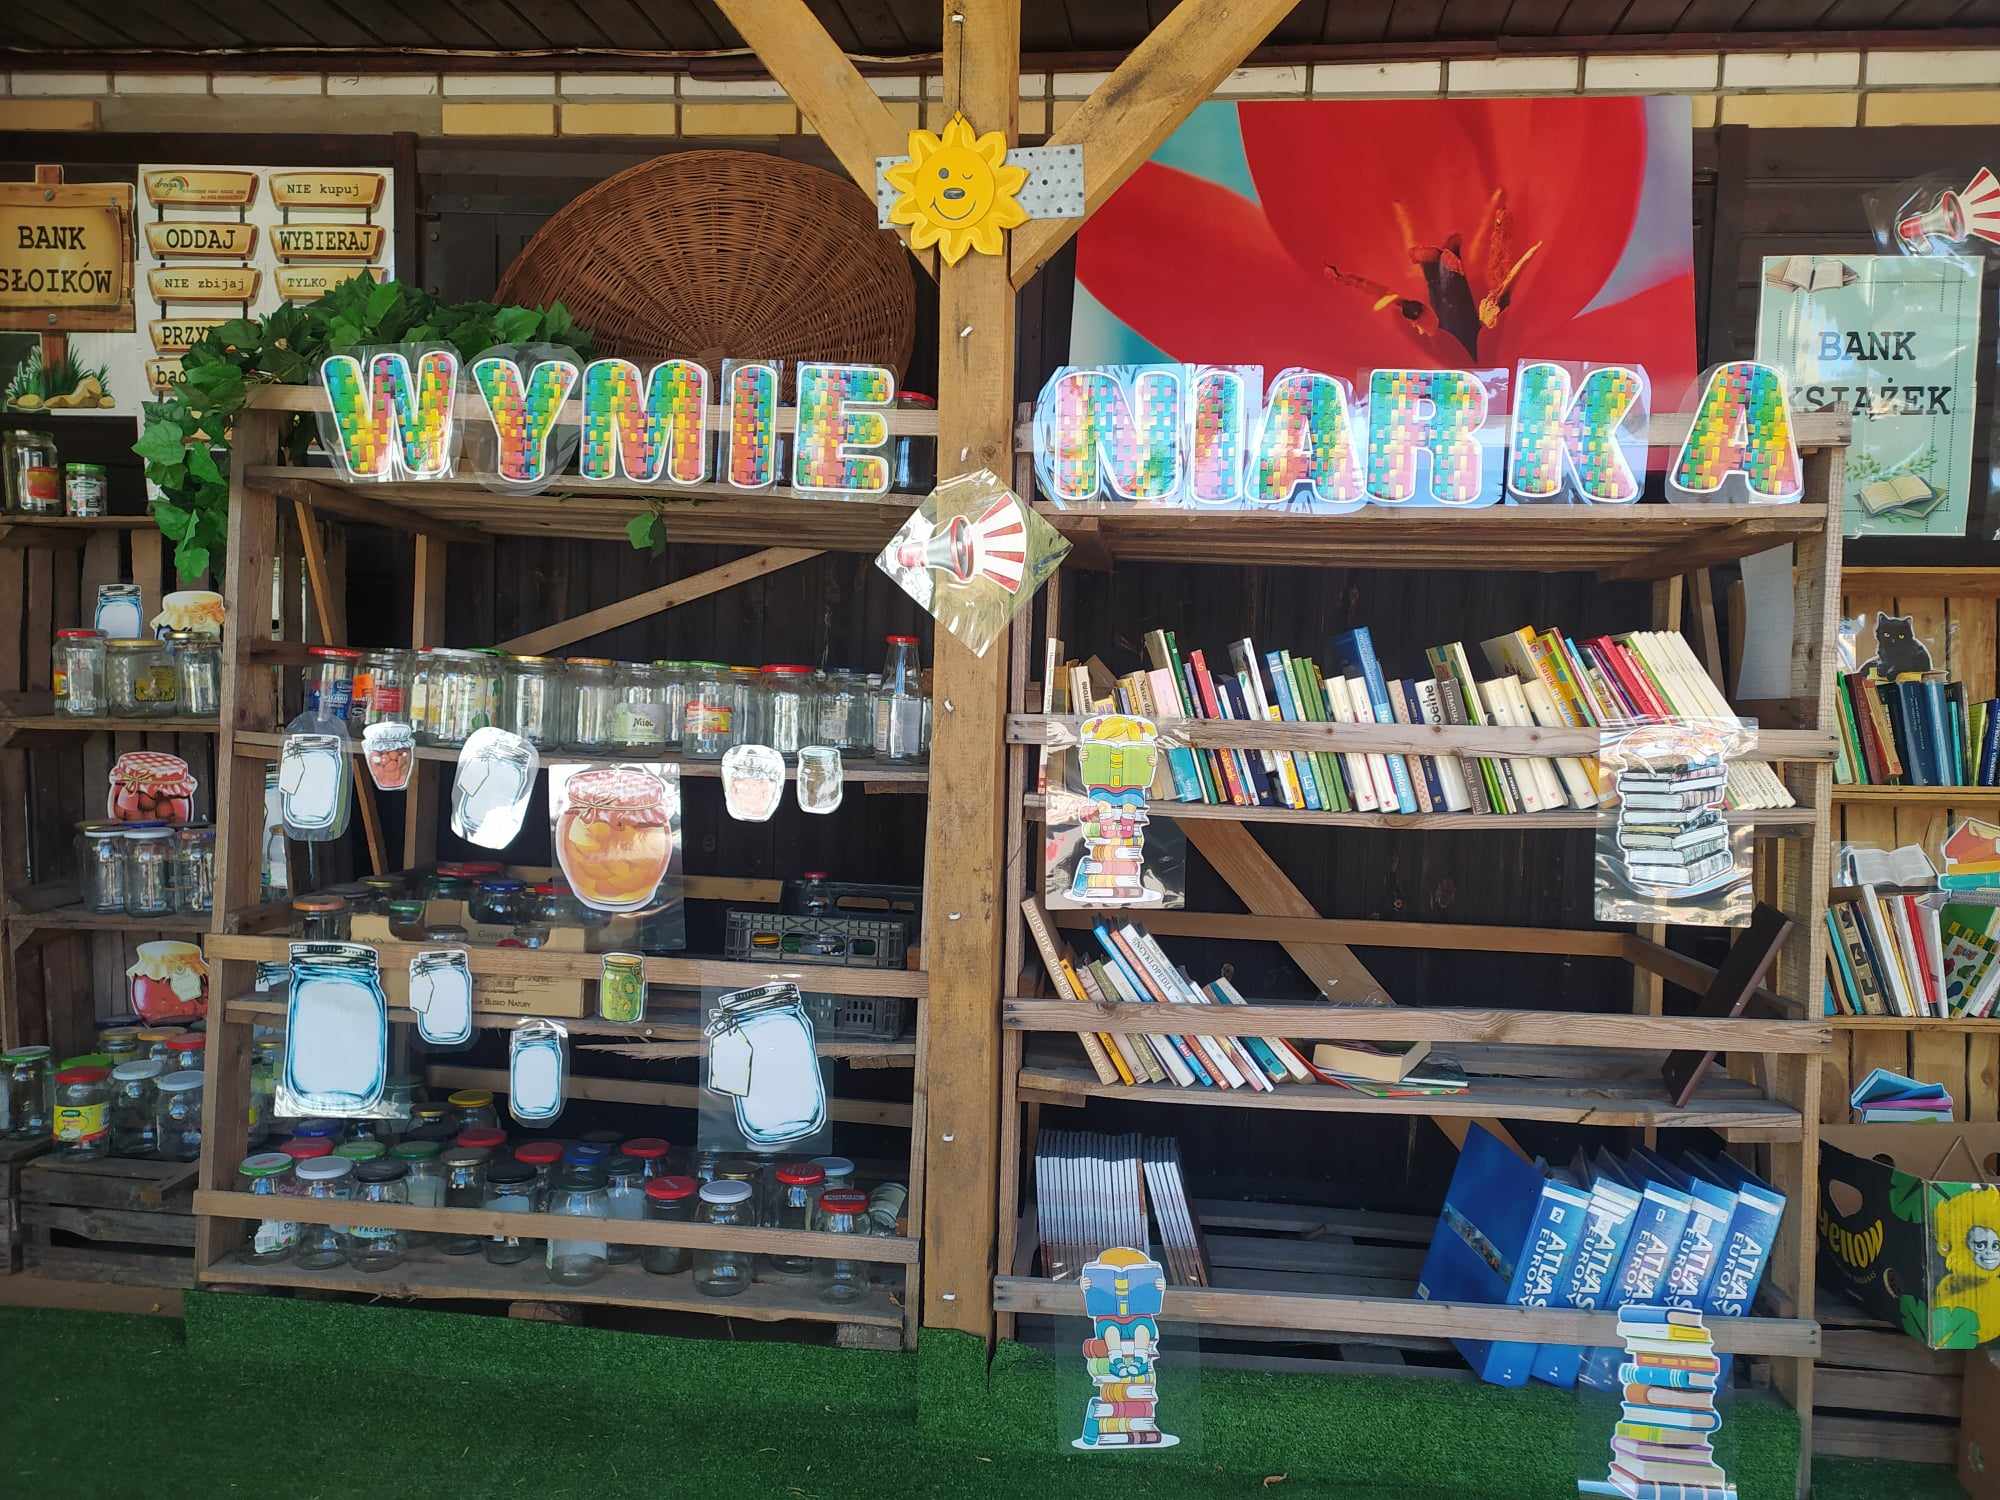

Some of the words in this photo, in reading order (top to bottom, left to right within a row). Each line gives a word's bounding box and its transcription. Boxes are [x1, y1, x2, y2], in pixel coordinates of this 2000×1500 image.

[287, 184, 311, 194] NIE
[320, 183, 360, 197] kupuj
[18, 225, 86, 250] BANK
[166, 228, 236, 250] ODDAJ
[279, 231, 372, 251] WYBIERAJ
[0, 263, 113, 294] SŁOIKÓW
[164, 278, 189, 289] NIE
[198, 277, 245, 291] zbijaj
[287, 278, 327, 289] TYLKO
[162, 326, 208, 346] PRZY
[1817, 331, 1917, 361] BANK
[320, 351, 896, 493] WYMIE
[1519, 1227, 1550, 1306] EUROPY
[1530, 1228, 1568, 1307] ATLAS
[1567, 1226, 1600, 1306] EUROPY
[1575, 1228, 1617, 1309] ATLAS
[1632, 1235, 1669, 1305] ATLA
[1663, 1227, 1695, 1307] EUROPY
[1672, 1229, 1713, 1309] ATLAS
[1712, 1231, 1744, 1311] EUROPY
[1724, 1234, 1763, 1317] ATLAS
